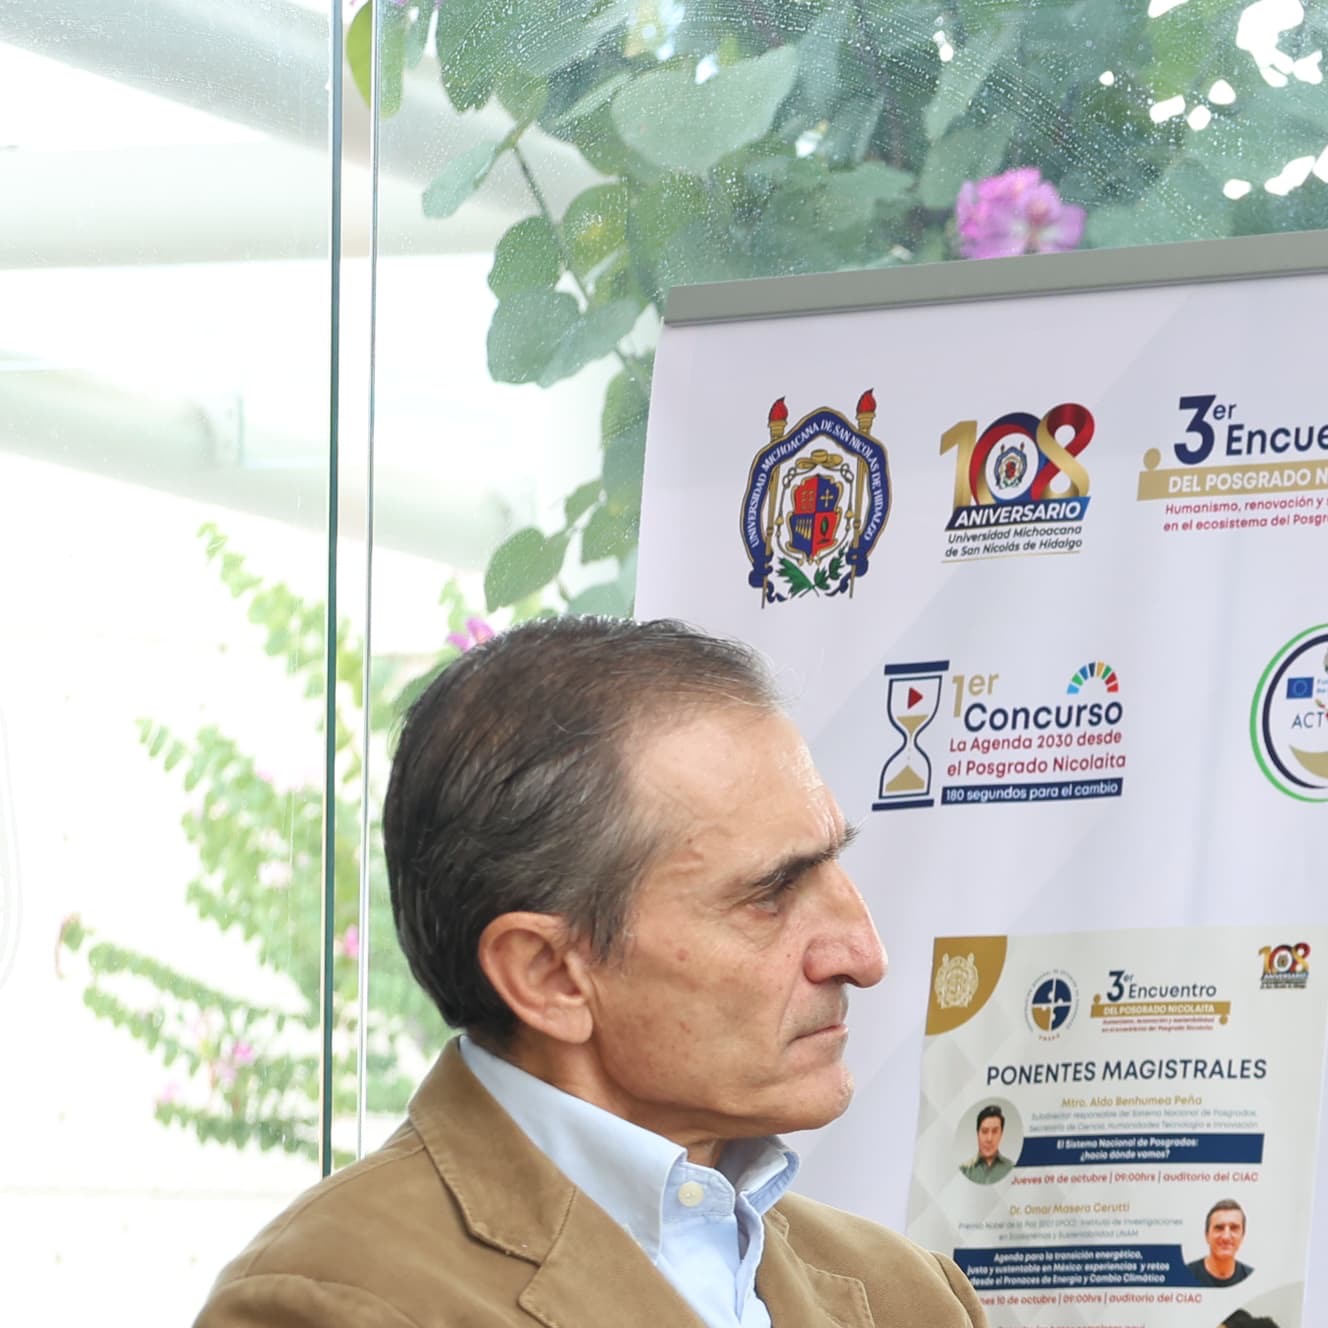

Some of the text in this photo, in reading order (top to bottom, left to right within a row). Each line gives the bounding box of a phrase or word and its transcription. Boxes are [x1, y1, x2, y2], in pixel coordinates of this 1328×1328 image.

[1168, 476, 1200, 493] DEL
[1206, 468, 1311, 490] POSGRADO
[955, 502, 1081, 528] ANIVERSARIO
[1165, 501, 1241, 515] Humanismo,
[1244, 496, 1313, 511] renovación
[1316, 498, 1323, 509] y
[1163, 520, 1178, 532] en
[1182, 518, 1192, 530] el
[1196, 517, 1267, 530] ecosistema
[1271, 513, 1289, 526] del
[949, 525, 1081, 544] Universidad Michoacana
[945, 539, 1082, 557] de San Nicolás de Hidalgo
[952, 674, 999, 717] 1er
[964, 701, 1123, 732] Concurso
[1291, 712, 1324, 728] ACT
[950, 731, 1122, 754] La Agenda 2030 desde
[947, 753, 1126, 778] el Posgrado Nicolaita
[946, 782, 1118, 802] 180 segundos para el cambio
[1128, 985, 1216, 999] Encuentro
[987, 1059, 1267, 1086] PONENTES MAGISTRALES
[1011, 1174, 1041, 1185] Jueves
[1070, 1172, 1107, 1183] octubre
[1163, 1171, 1209, 1182] auditorio
[1213, 1171, 1229, 1182] del
[1232, 1172, 1259, 1182] CIAC
